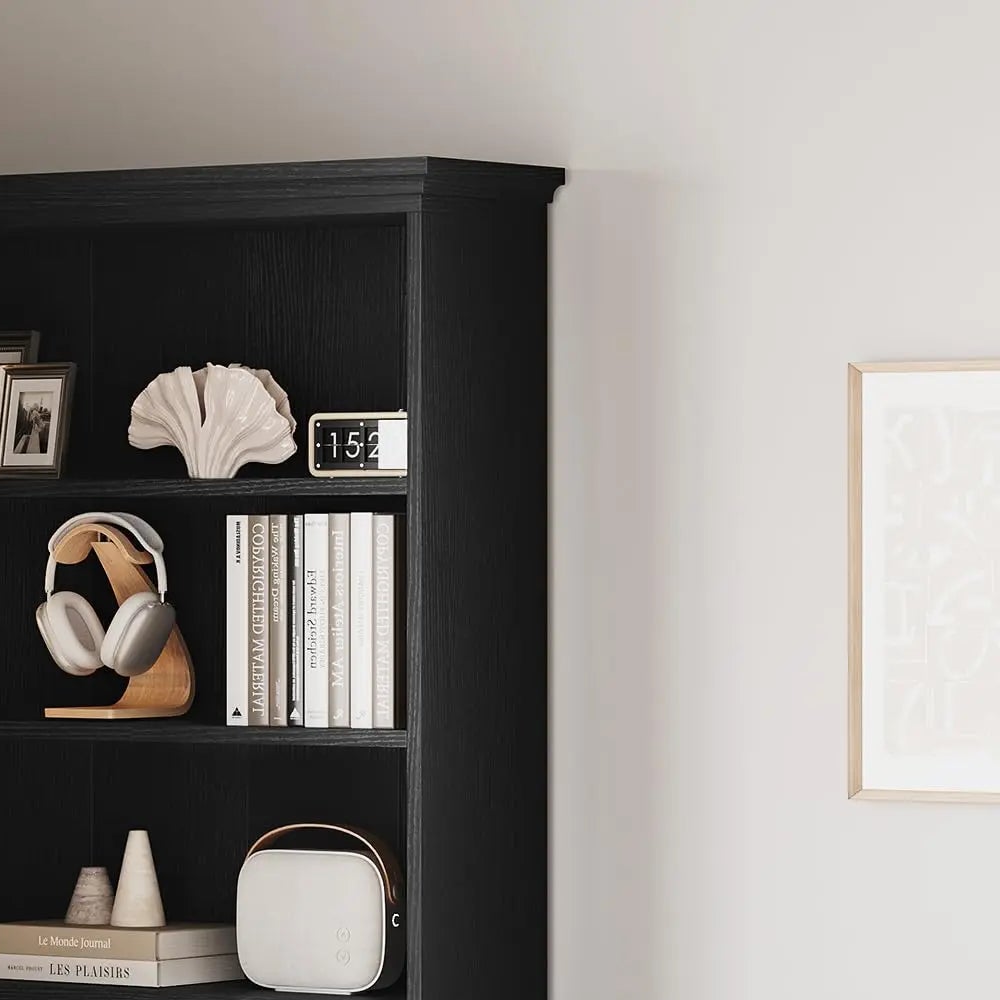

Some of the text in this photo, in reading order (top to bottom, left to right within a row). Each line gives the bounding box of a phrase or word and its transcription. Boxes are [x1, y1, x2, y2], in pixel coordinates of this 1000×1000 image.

[38, 935, 112, 949] Le Monde Journal
[50, 963, 70, 976] LES
[76, 964, 131, 978] PLAISIRS
